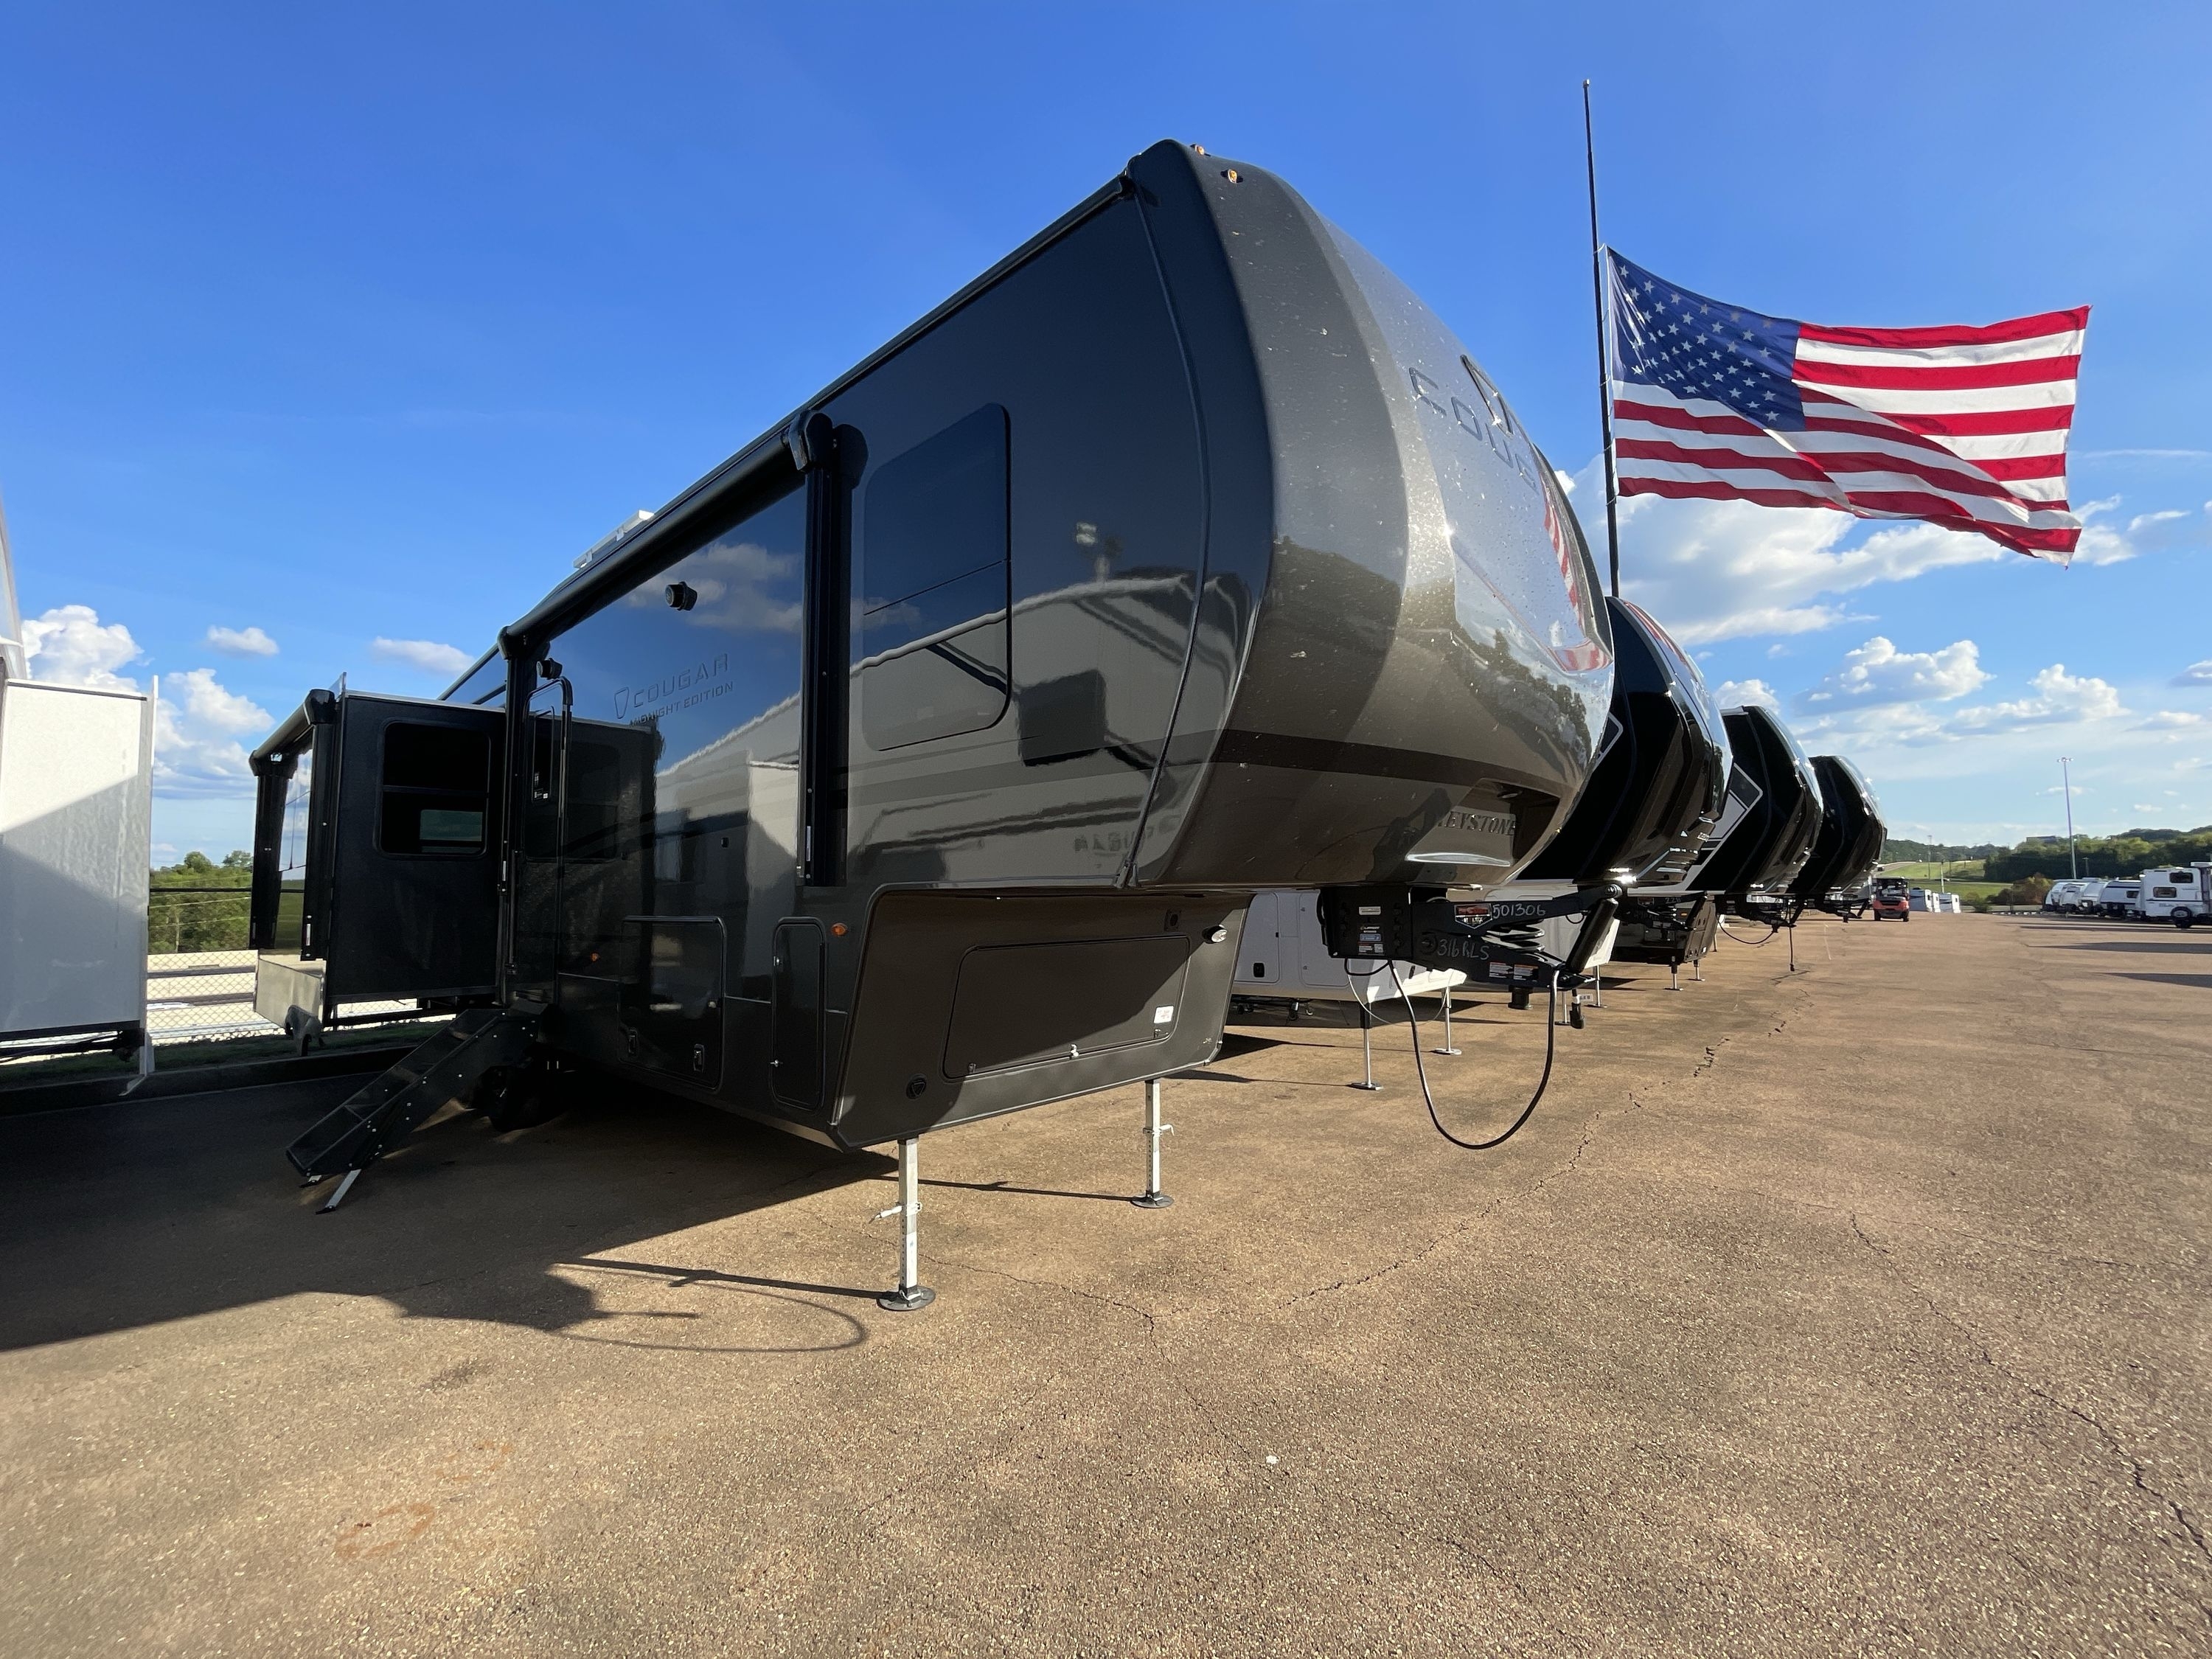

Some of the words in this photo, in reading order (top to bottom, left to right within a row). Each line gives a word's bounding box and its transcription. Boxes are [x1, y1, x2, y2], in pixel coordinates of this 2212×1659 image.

[1408, 366, 1540, 496] COUG
[684, 681, 734, 709] EDITION
[1438, 811, 1516, 836] EYSTONE
